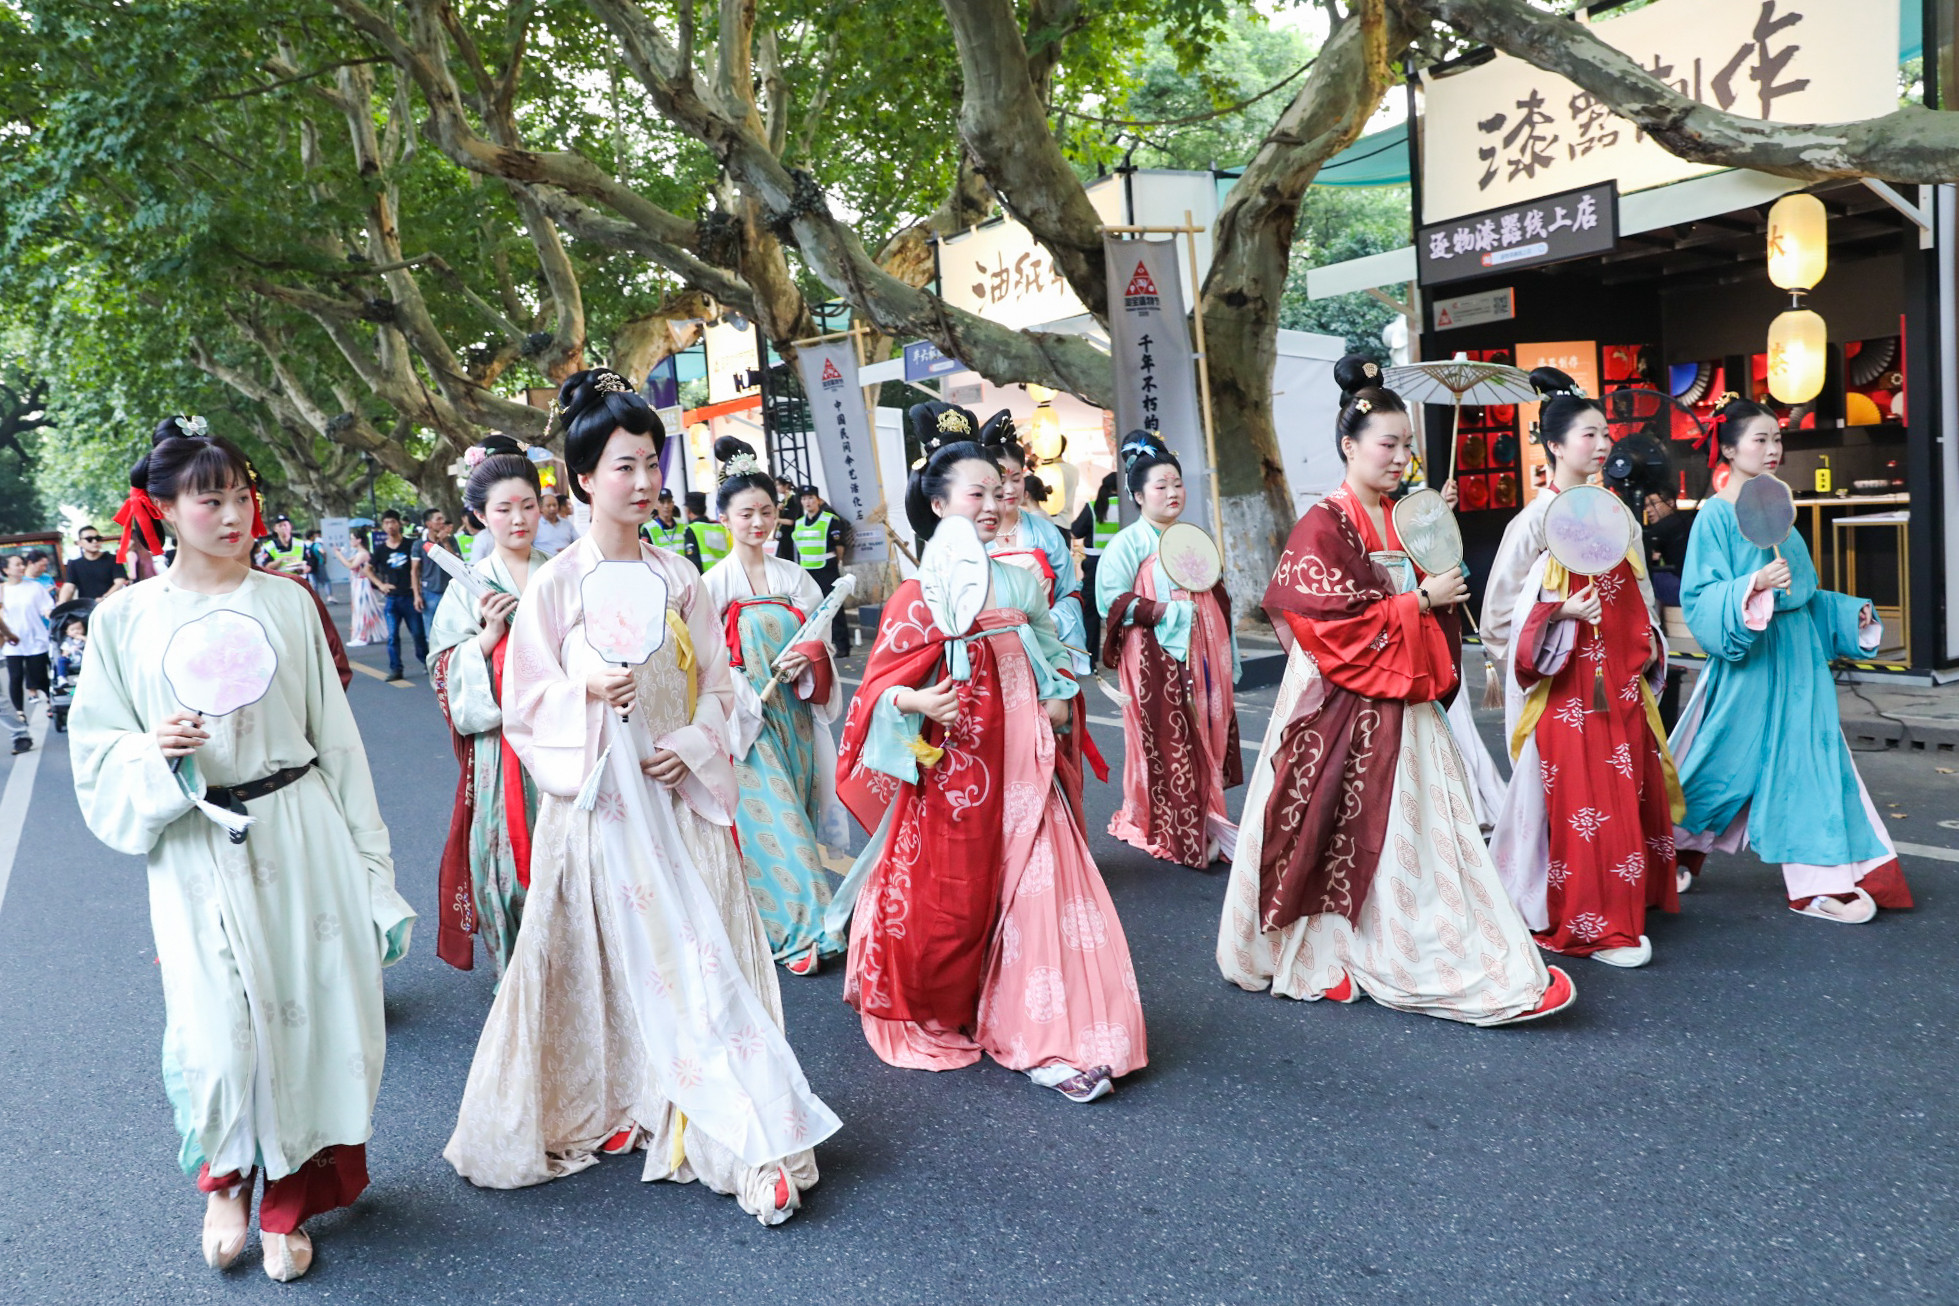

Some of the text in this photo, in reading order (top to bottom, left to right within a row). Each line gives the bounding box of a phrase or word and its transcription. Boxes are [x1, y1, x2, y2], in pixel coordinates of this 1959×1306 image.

[1138, 334, 1160, 431] 千年不朽的
